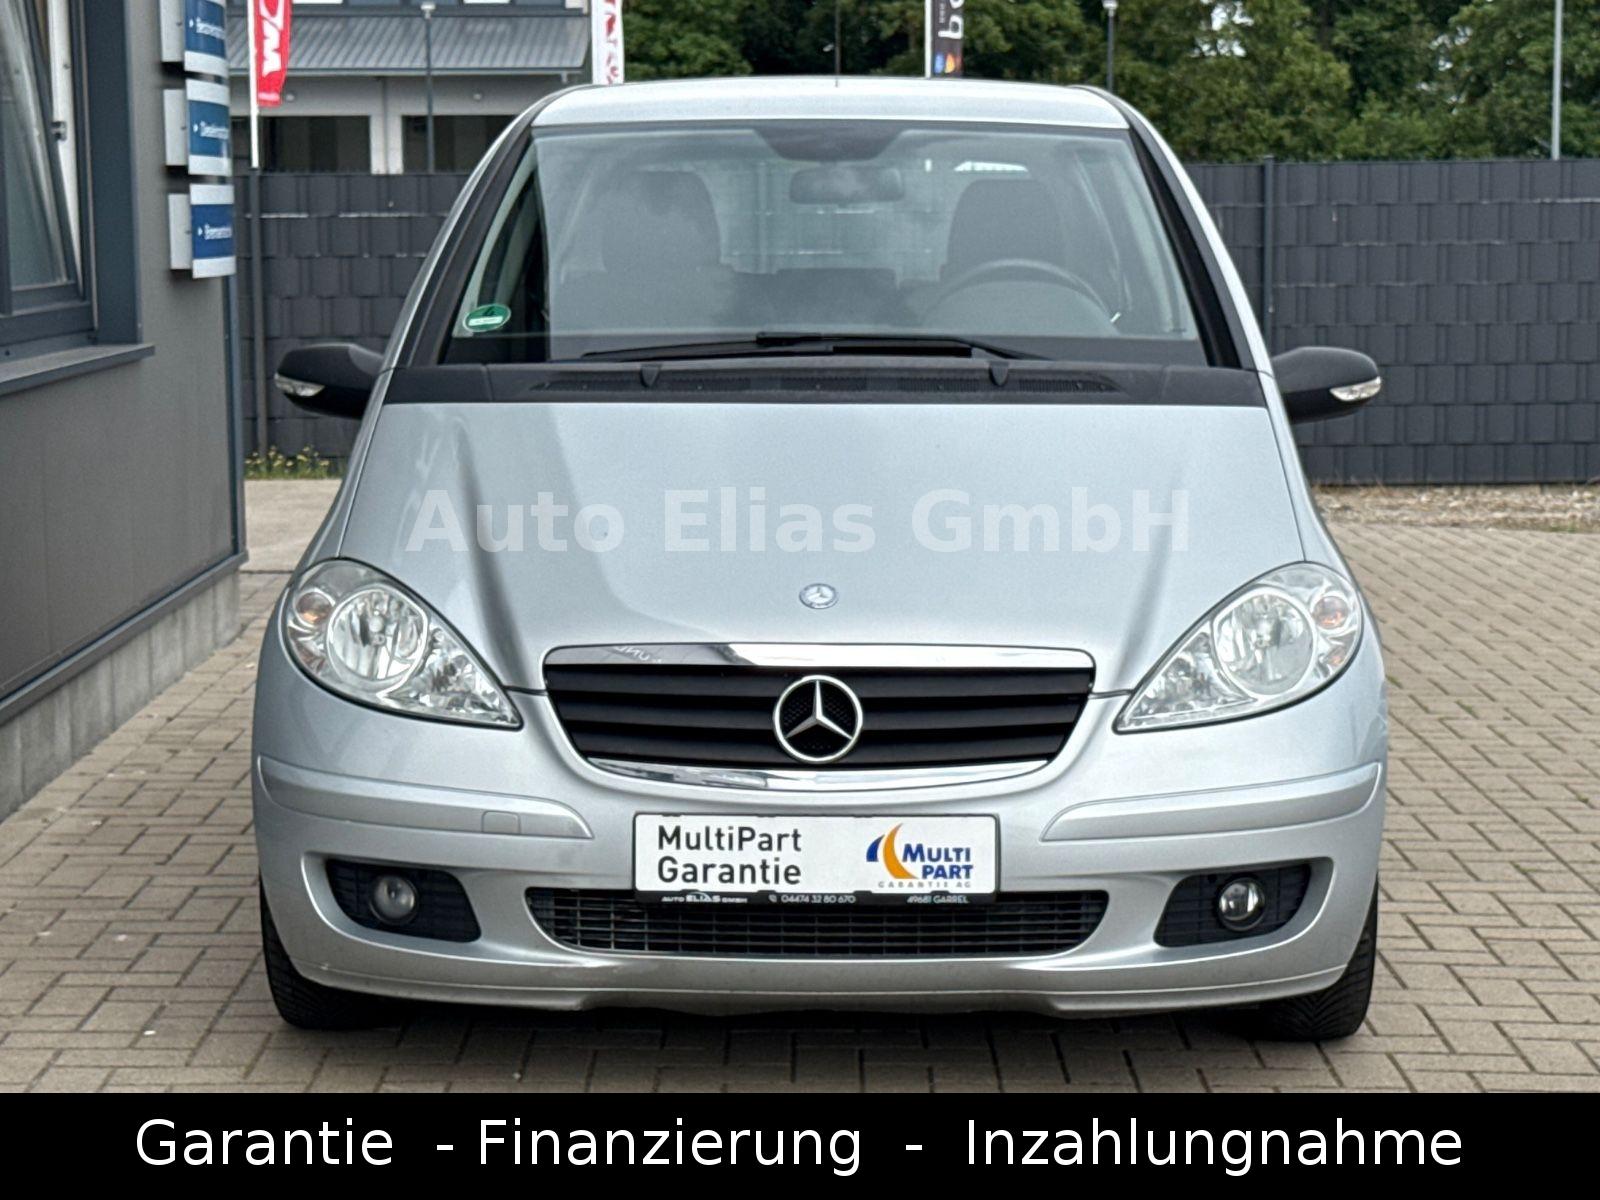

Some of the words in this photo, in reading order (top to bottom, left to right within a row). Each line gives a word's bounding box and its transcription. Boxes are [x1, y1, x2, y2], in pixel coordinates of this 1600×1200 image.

[658, 825, 802, 851] MultiPart
[658, 855, 802, 885] Garantie
[921, 864, 974, 880] PART
[877, 881, 949, 889] GARANTIE
[661, 895, 685, 903] AUTO
[780, 893, 810, 904] 04474
[823, 894, 837, 904] 80
[838, 894, 857, 904] 670
